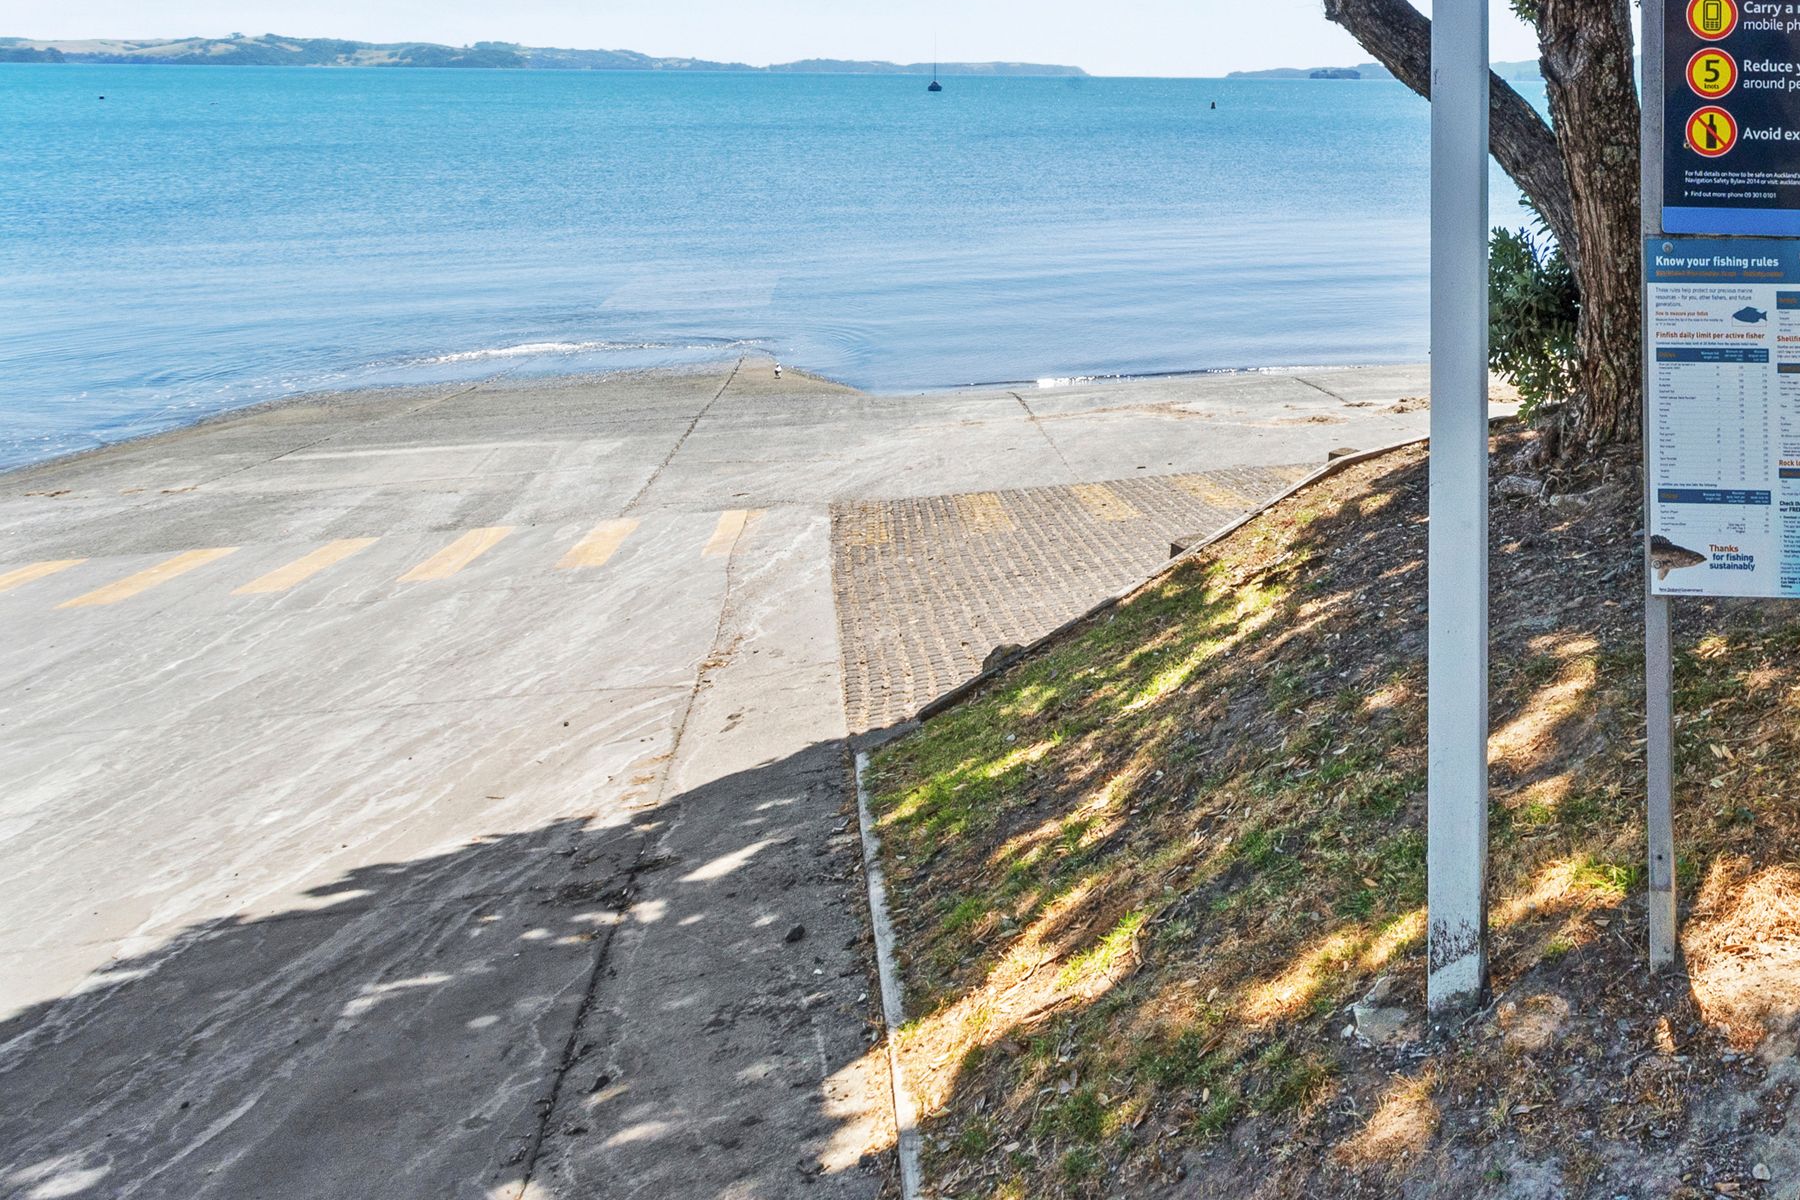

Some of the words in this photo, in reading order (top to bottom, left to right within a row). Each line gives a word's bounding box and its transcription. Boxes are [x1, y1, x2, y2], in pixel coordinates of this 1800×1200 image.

[1744, 1, 1782, 17] Carry
[1785, 5, 1793, 14] a
[1744, 18, 1783, 30] mobile
[1704, 60, 1720, 82] 5
[1744, 59, 1793, 72] Reduce
[1743, 78, 1785, 89] around
[1743, 127, 1781, 140] Avoid
[1656, 256, 1685, 266] Know
[1687, 258, 1711, 268] your
[1713, 256, 1749, 269] fishing
[1751, 257, 1779, 267] rules
[1679, 332, 1695, 340] daily
[1709, 544, 1739, 552] Thanks
[1712, 553, 1725, 561] for
[1726, 553, 1754, 563] fishing
[1709, 562, 1755, 572] sustainably
